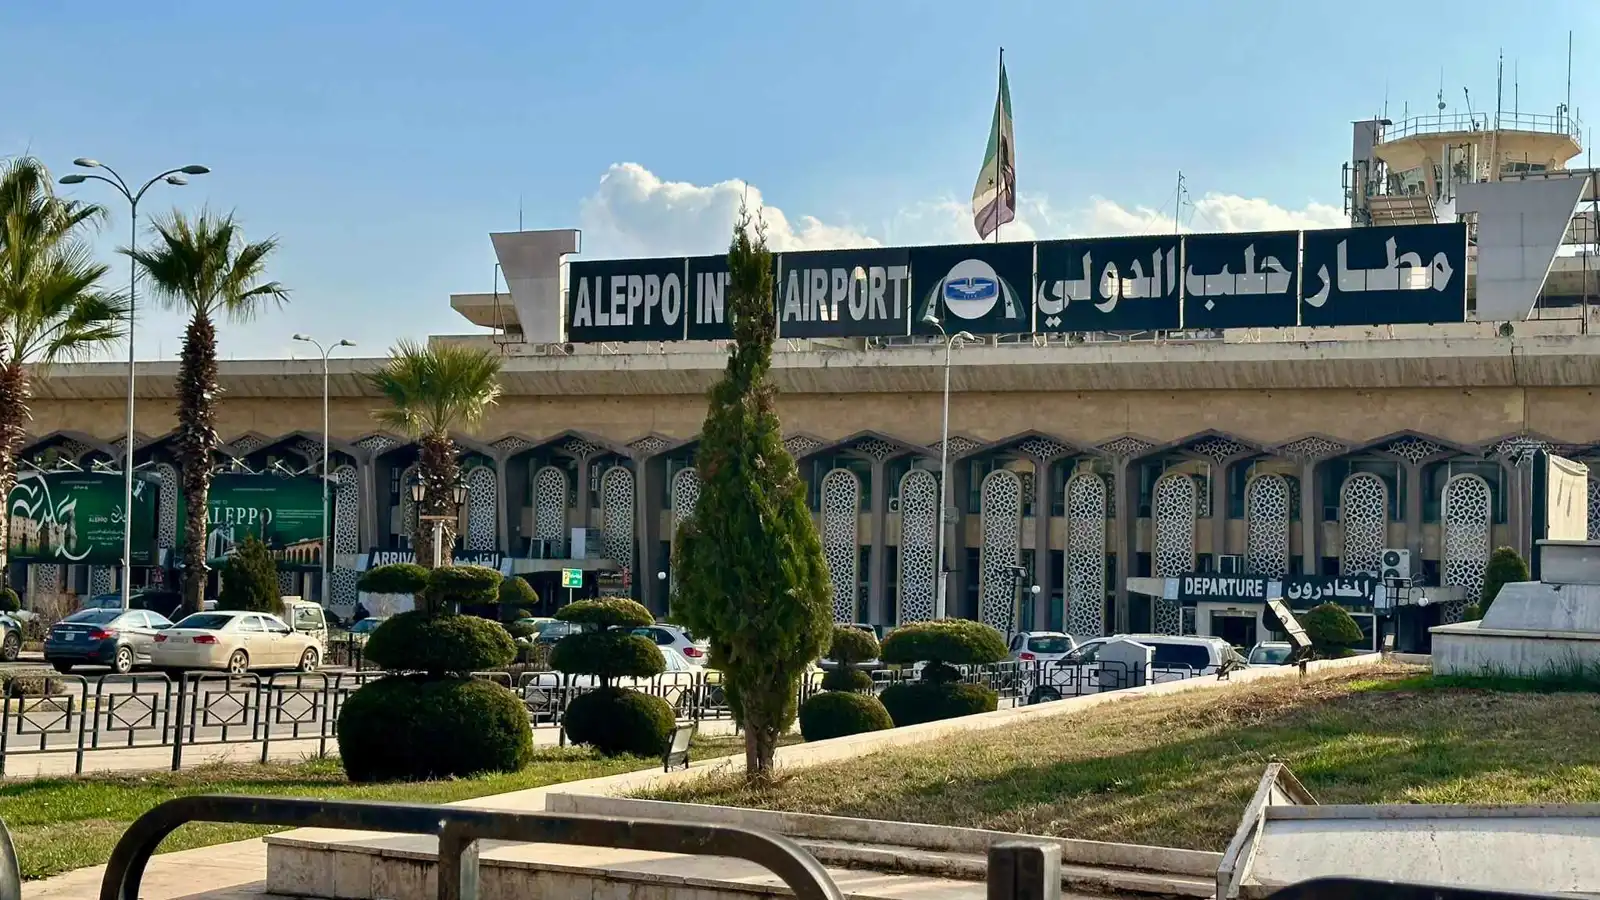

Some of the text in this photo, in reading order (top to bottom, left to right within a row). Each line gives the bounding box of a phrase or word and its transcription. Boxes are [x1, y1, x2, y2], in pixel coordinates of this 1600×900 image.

[1037, 235, 1454, 327] مطار حلب الدولي
[573, 272, 681, 328] ALEPPO
[782, 264, 908, 322] AIRPORT
[206, 507, 273, 525] ALEPPO
[372, 551, 417, 566] ARRIVA
[1184, 577, 1263, 597] DEPARTURE
[1287, 579, 1369, 600] المغادرون
